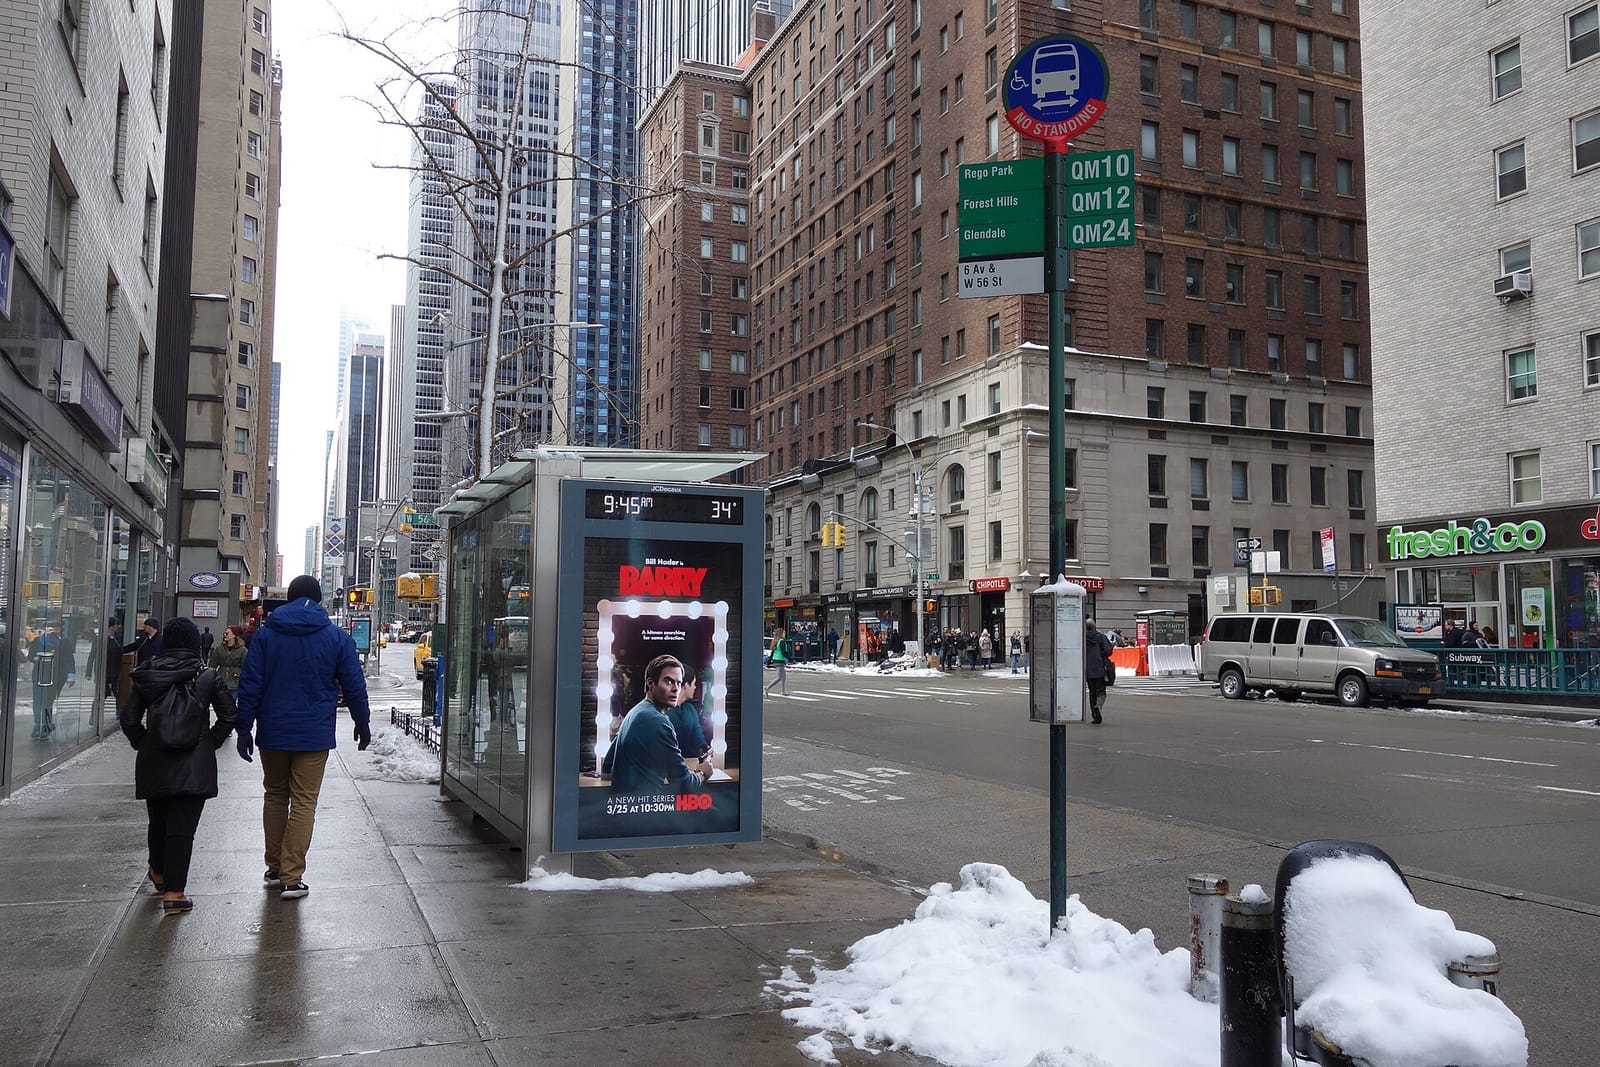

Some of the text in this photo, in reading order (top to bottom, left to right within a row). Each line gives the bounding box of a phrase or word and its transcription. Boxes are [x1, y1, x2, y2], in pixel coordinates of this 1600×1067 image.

[1014, 104, 1098, 136] NO STANDING
[964, 165, 1014, 180] Rego Park
[1071, 154, 1130, 181] QM10
[963, 196, 1018, 210] Forest Hills
[1072, 185, 1130, 213] QM12
[964, 228, 1006, 240] Glendale
[1072, 218, 1131, 245] QM24
[964, 263, 996, 275] 6 Av &
[964, 276, 1002, 289] W 56 St
[711, 501, 738, 519] 34°
[1387, 518, 1546, 560] fresh&co
[645, 558, 656, 566] Bill
[619, 565, 708, 597] BARRY
[976, 580, 1006, 589] CHIPOTLE
[1449, 653, 1482, 664] Subway
[615, 796, 636, 804] NEW
[638, 795, 650, 803] HIT
[652, 794, 675, 803] SERIES
[675, 793, 713, 811] HBO
[606, 803, 675, 815] 3/25 AT 10:30PM
